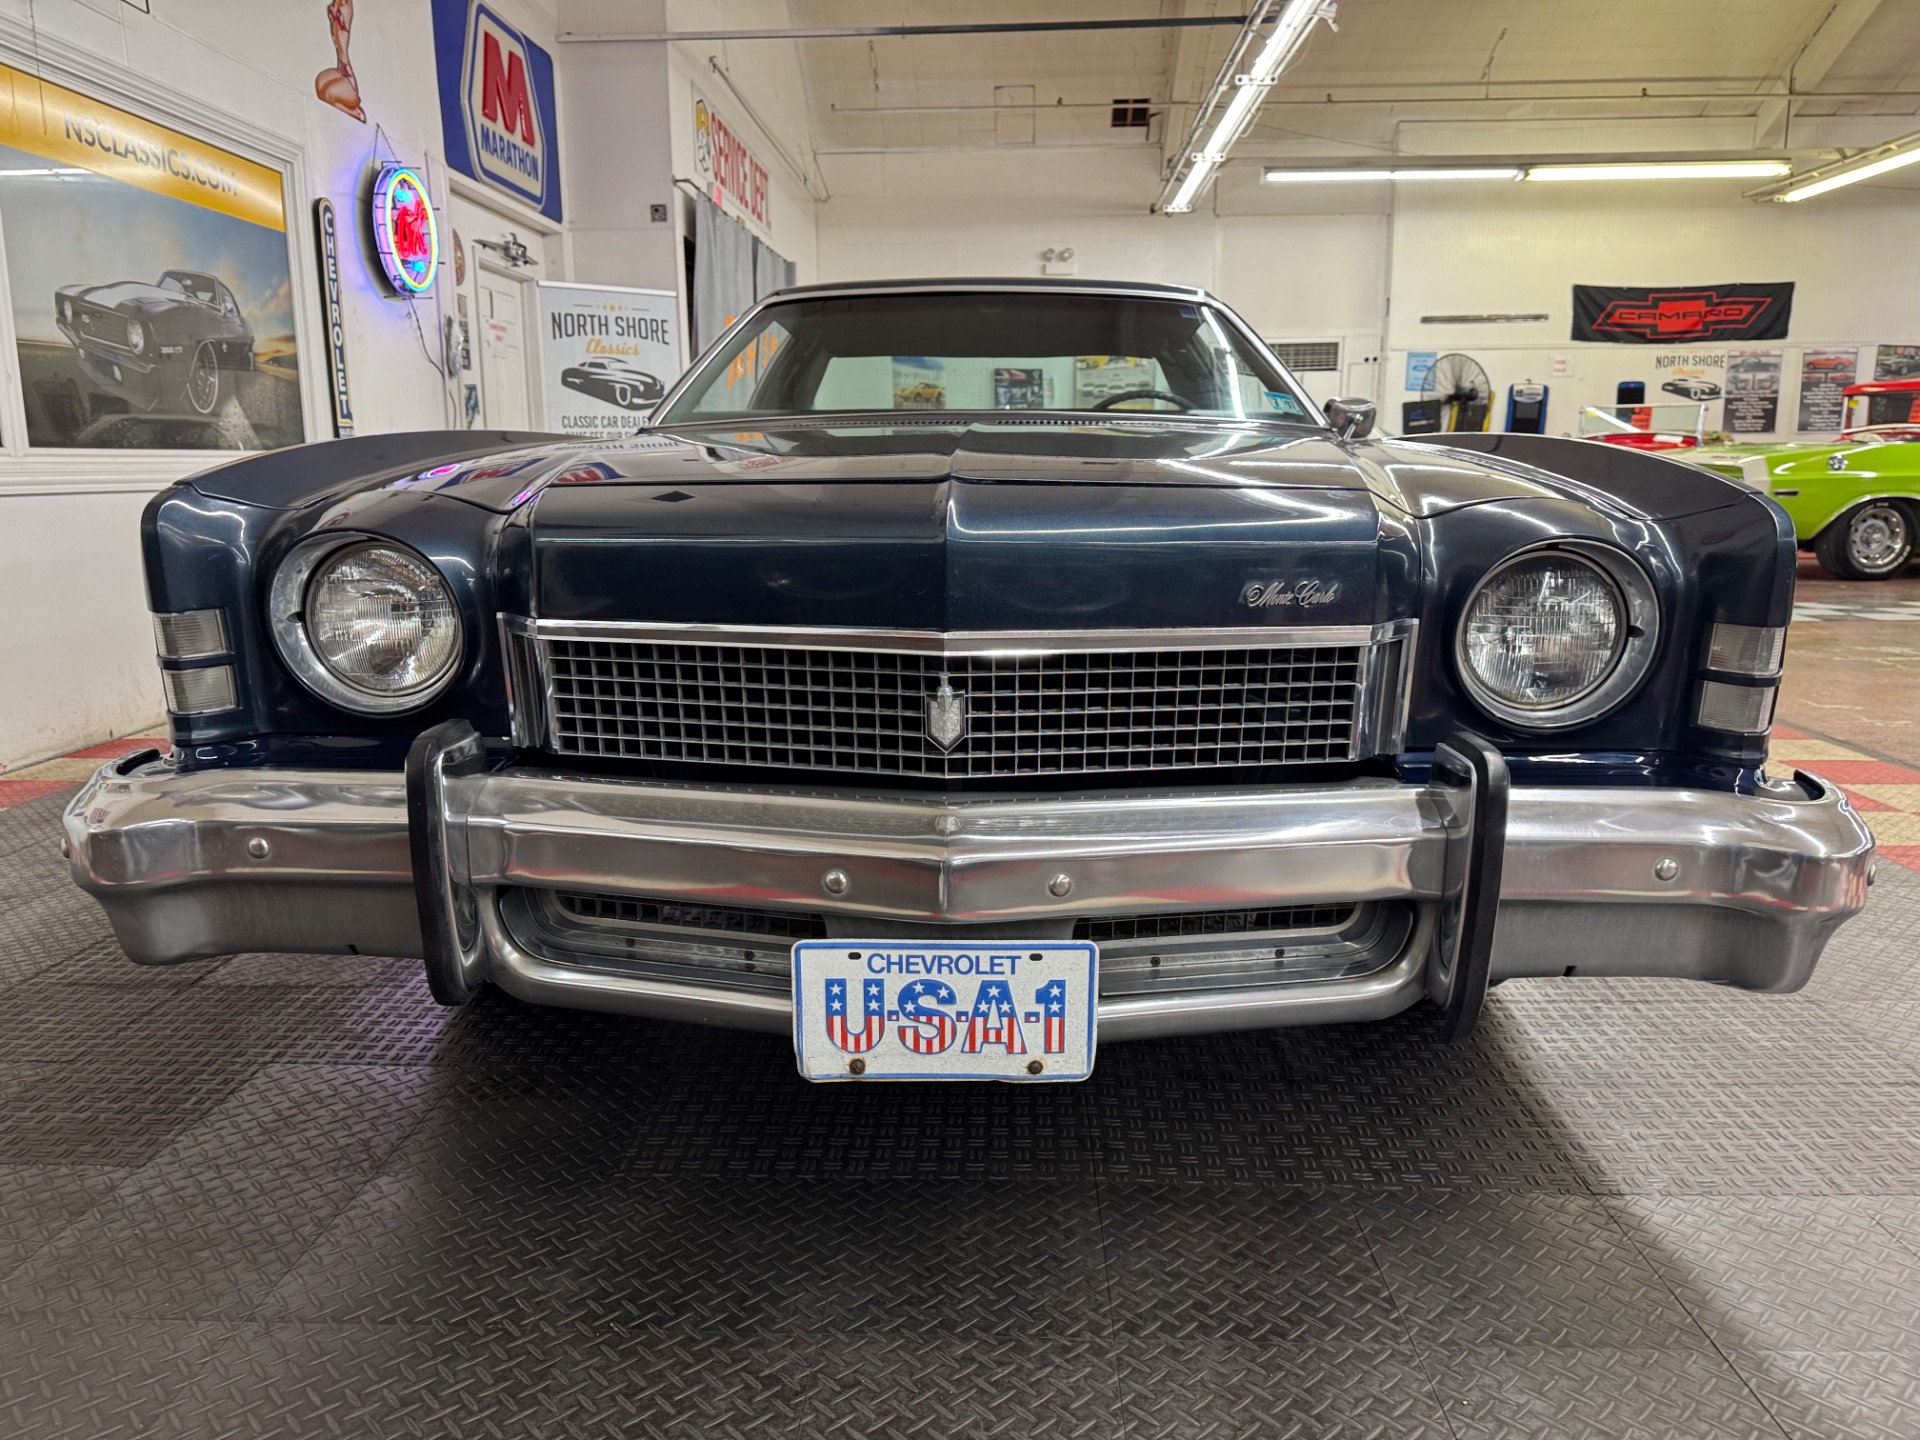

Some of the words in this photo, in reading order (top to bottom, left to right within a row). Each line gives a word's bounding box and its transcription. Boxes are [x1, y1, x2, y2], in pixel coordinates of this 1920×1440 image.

[63, 111, 239, 197] NSCLASSICS.COM
[480, 122, 540, 182] MARATHON
[710, 111, 749, 210] SERVICE
[322, 210, 349, 415] CHEVROLET
[1618, 307, 1743, 321] CAMARO
[551, 311, 610, 340] NORTH
[615, 315, 670, 346] SHORE
[585, 338, 641, 356] Classics
[1655, 355, 1690, 369] NORTH
[1691, 354, 1726, 369] SHORE
[561, 415, 599, 429] CLASSIC
[601, 415, 619, 429] CAR
[1246, 580, 1295, 608] Monte
[1294, 580, 1339, 608] Carlo
[866, 952, 1022, 976] CHEVROLET
[824, 977, 1067, 1055] U-S-A-1
